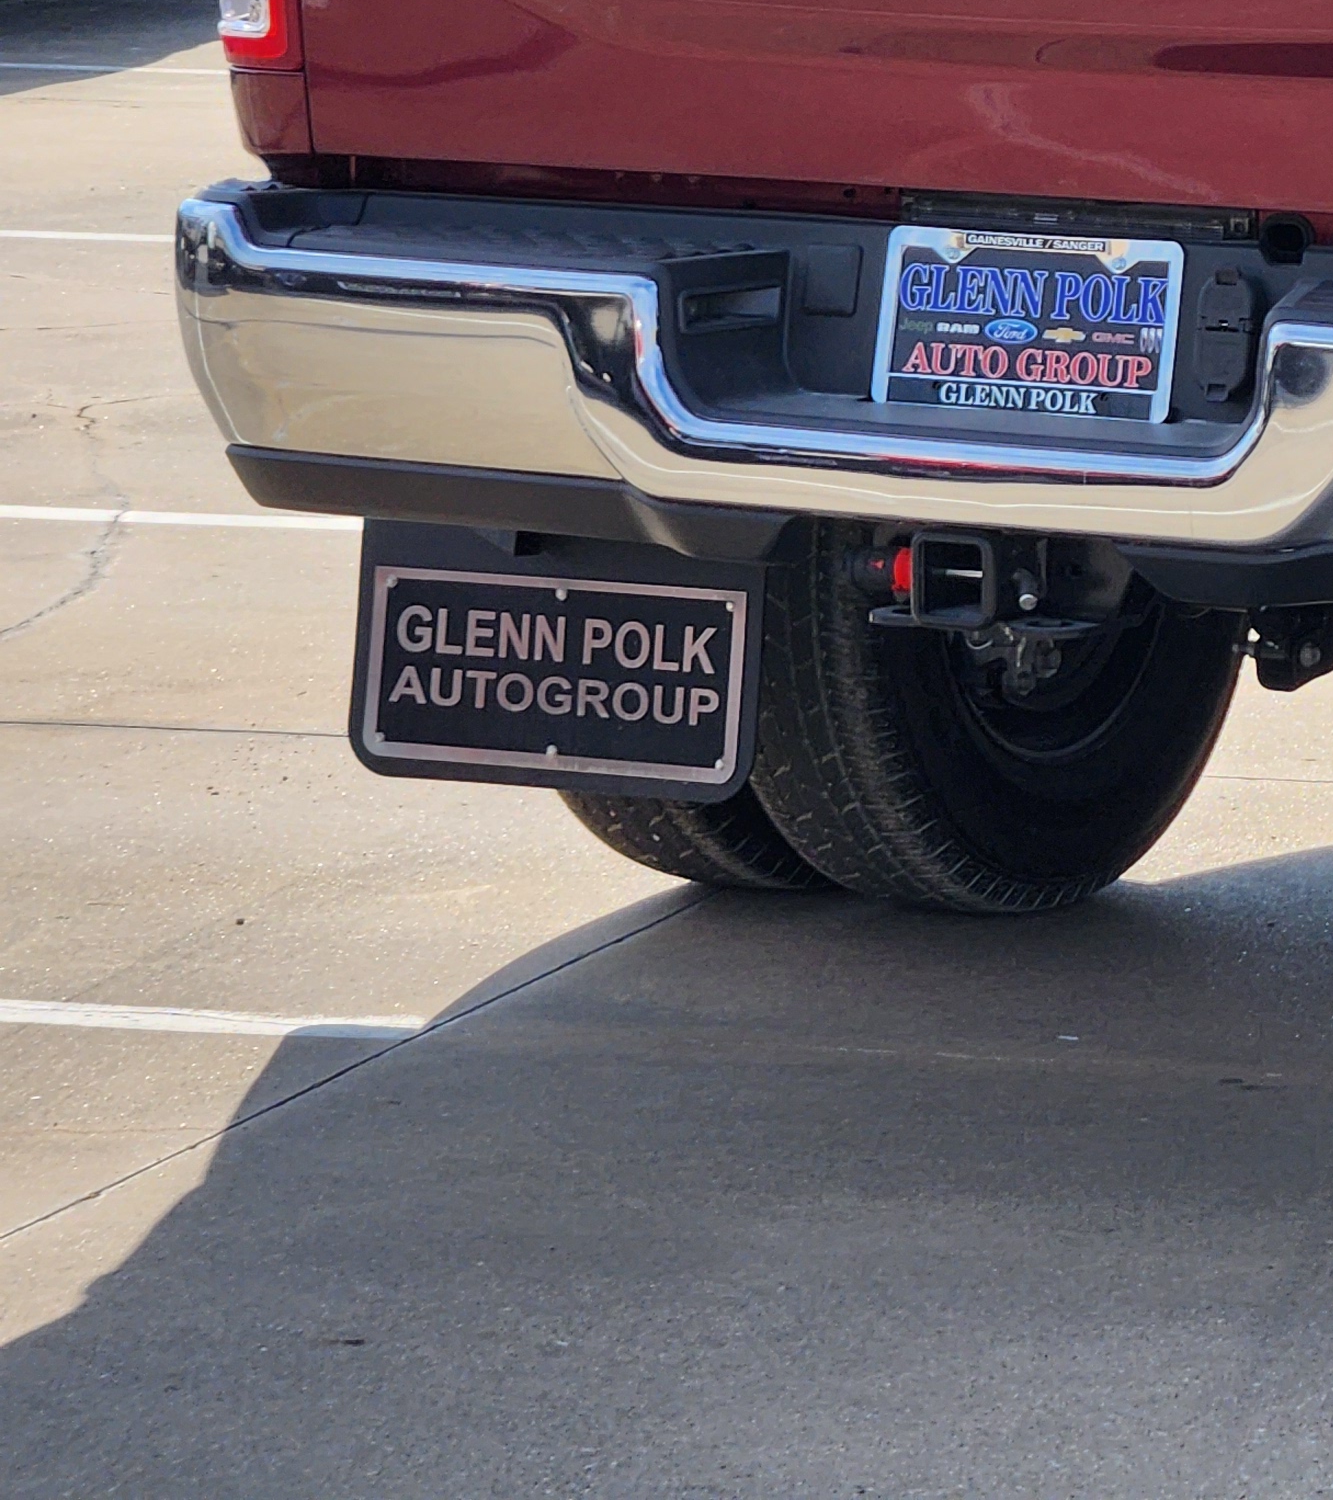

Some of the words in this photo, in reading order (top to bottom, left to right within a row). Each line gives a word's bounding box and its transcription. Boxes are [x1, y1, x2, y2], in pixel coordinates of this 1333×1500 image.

[967, 234, 1044, 249] GAINESVILLE
[1052, 240, 1105, 251] SANGER
[899, 263, 1050, 318] GLENN
[1051, 272, 1169, 325] POLK
[899, 318, 934, 335] Jeep
[936, 322, 980, 335] RAM
[993, 323, 1027, 341] Ford
[1091, 332, 1135, 345] GMC
[902, 341, 1009, 378] AUTO
[1016, 348, 1152, 388] GROUP
[939, 381, 1026, 410] GLENN
[1027, 388, 1099, 415] POLK
[396, 604, 567, 663] GLENN
[582, 617, 718, 675] POLK
[388, 665, 720, 727] AUTOGROUP
